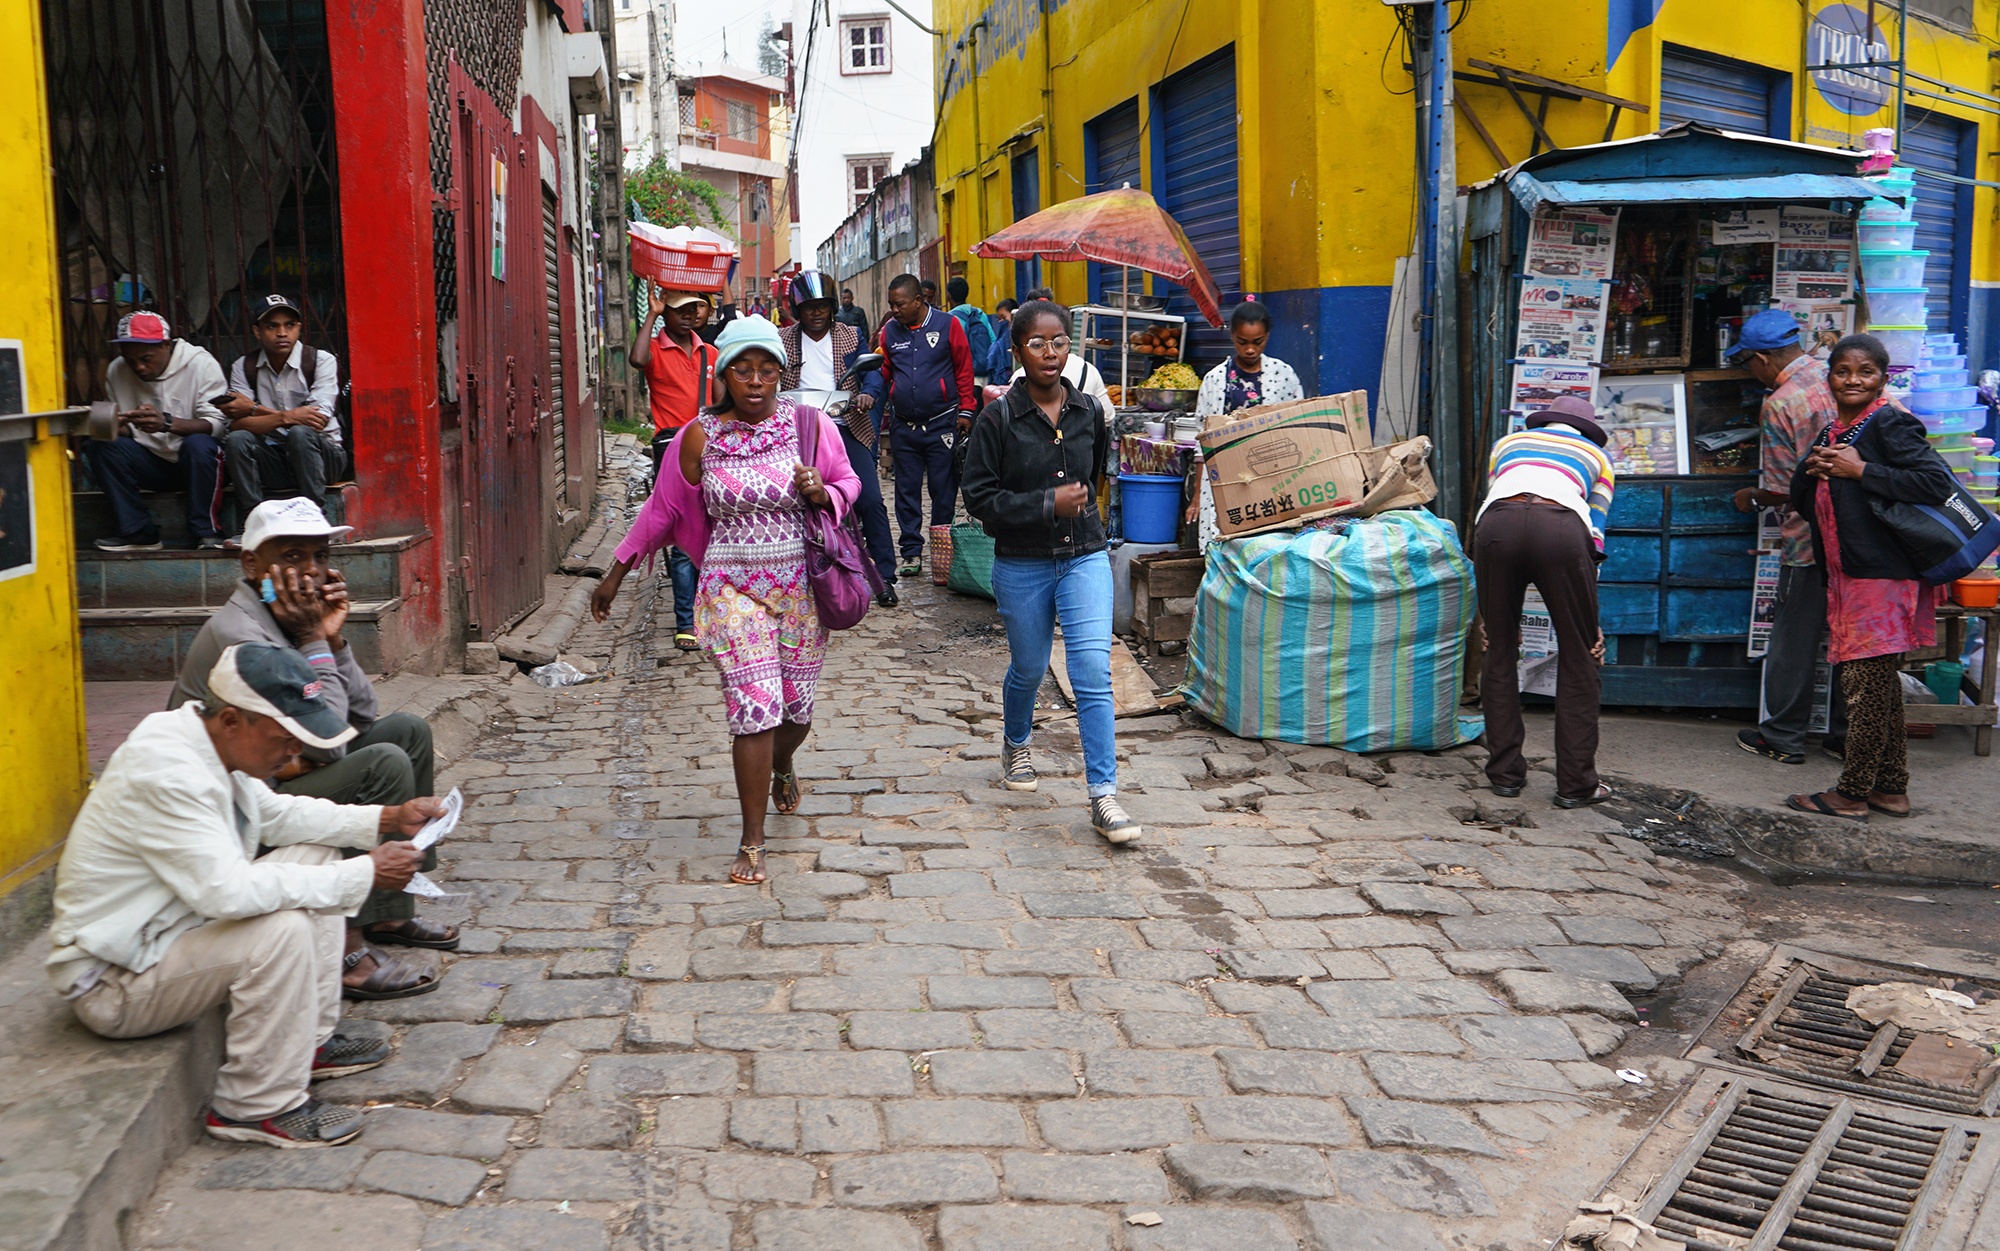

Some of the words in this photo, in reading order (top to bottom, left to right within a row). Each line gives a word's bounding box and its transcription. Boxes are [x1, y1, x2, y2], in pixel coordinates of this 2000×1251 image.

[1815, 23, 1887, 94] TRUST
[1533, 219, 1573, 241] MIDI
[1780, 221, 1813, 229] Basy
[1525, 368, 1542, 378] Vidy
[1555, 371, 1588, 381] Varotra
[1297, 481, 1338, 507] 650
[1226, 493, 1295, 526] 环保方盒
[1521, 615, 1549, 627] Raha
